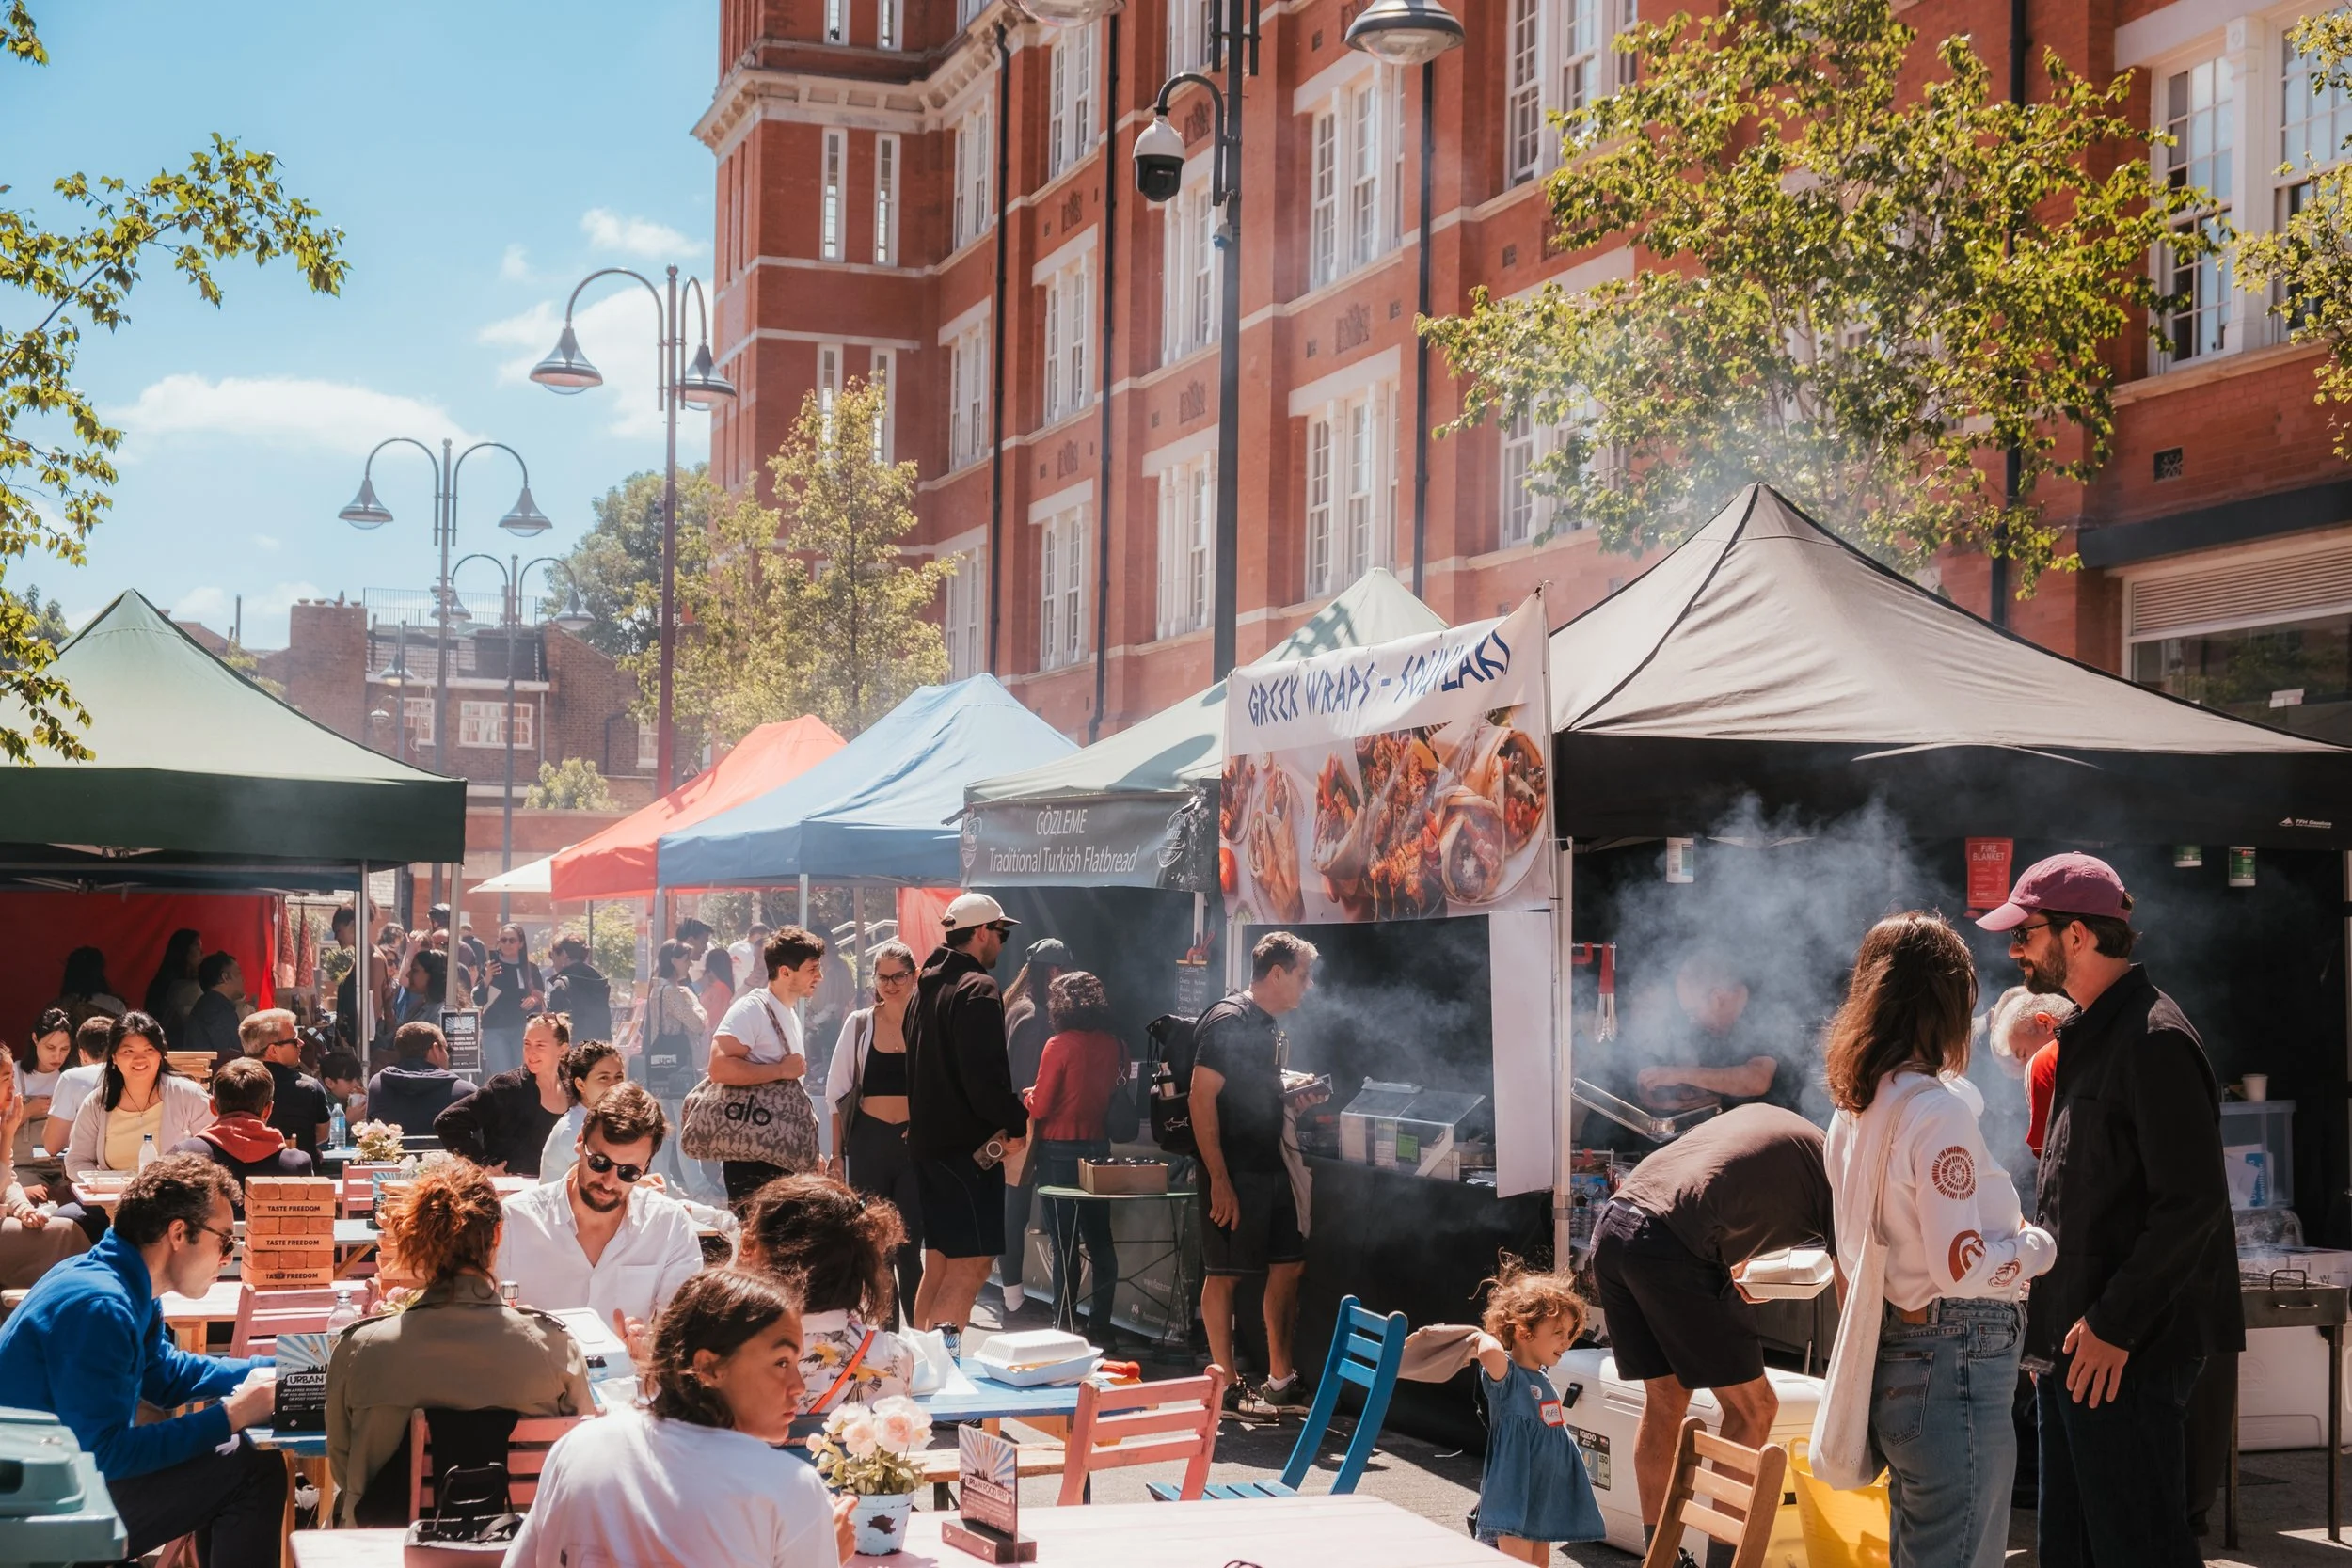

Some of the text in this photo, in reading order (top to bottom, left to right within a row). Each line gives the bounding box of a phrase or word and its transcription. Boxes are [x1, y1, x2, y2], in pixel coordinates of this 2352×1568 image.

[1248, 673, 1299, 727] GREEK
[1305, 661, 1375, 716] WRAPS
[1393, 629, 1511, 704] SOUVLAKI
[1036, 804, 1088, 836] GÖZLEME
[989, 845, 1140, 874] Traditional Turkish Flatbread
[1972, 852, 2005, 861] BLANKET
[1980, 844, 1997, 853] FIRE
[724, 1094, 772, 1127] alo
[289, 1375, 325, 1385] URBAN
[966, 1476, 983, 1491] URBAN
[982, 1483, 997, 1497] FOOD
